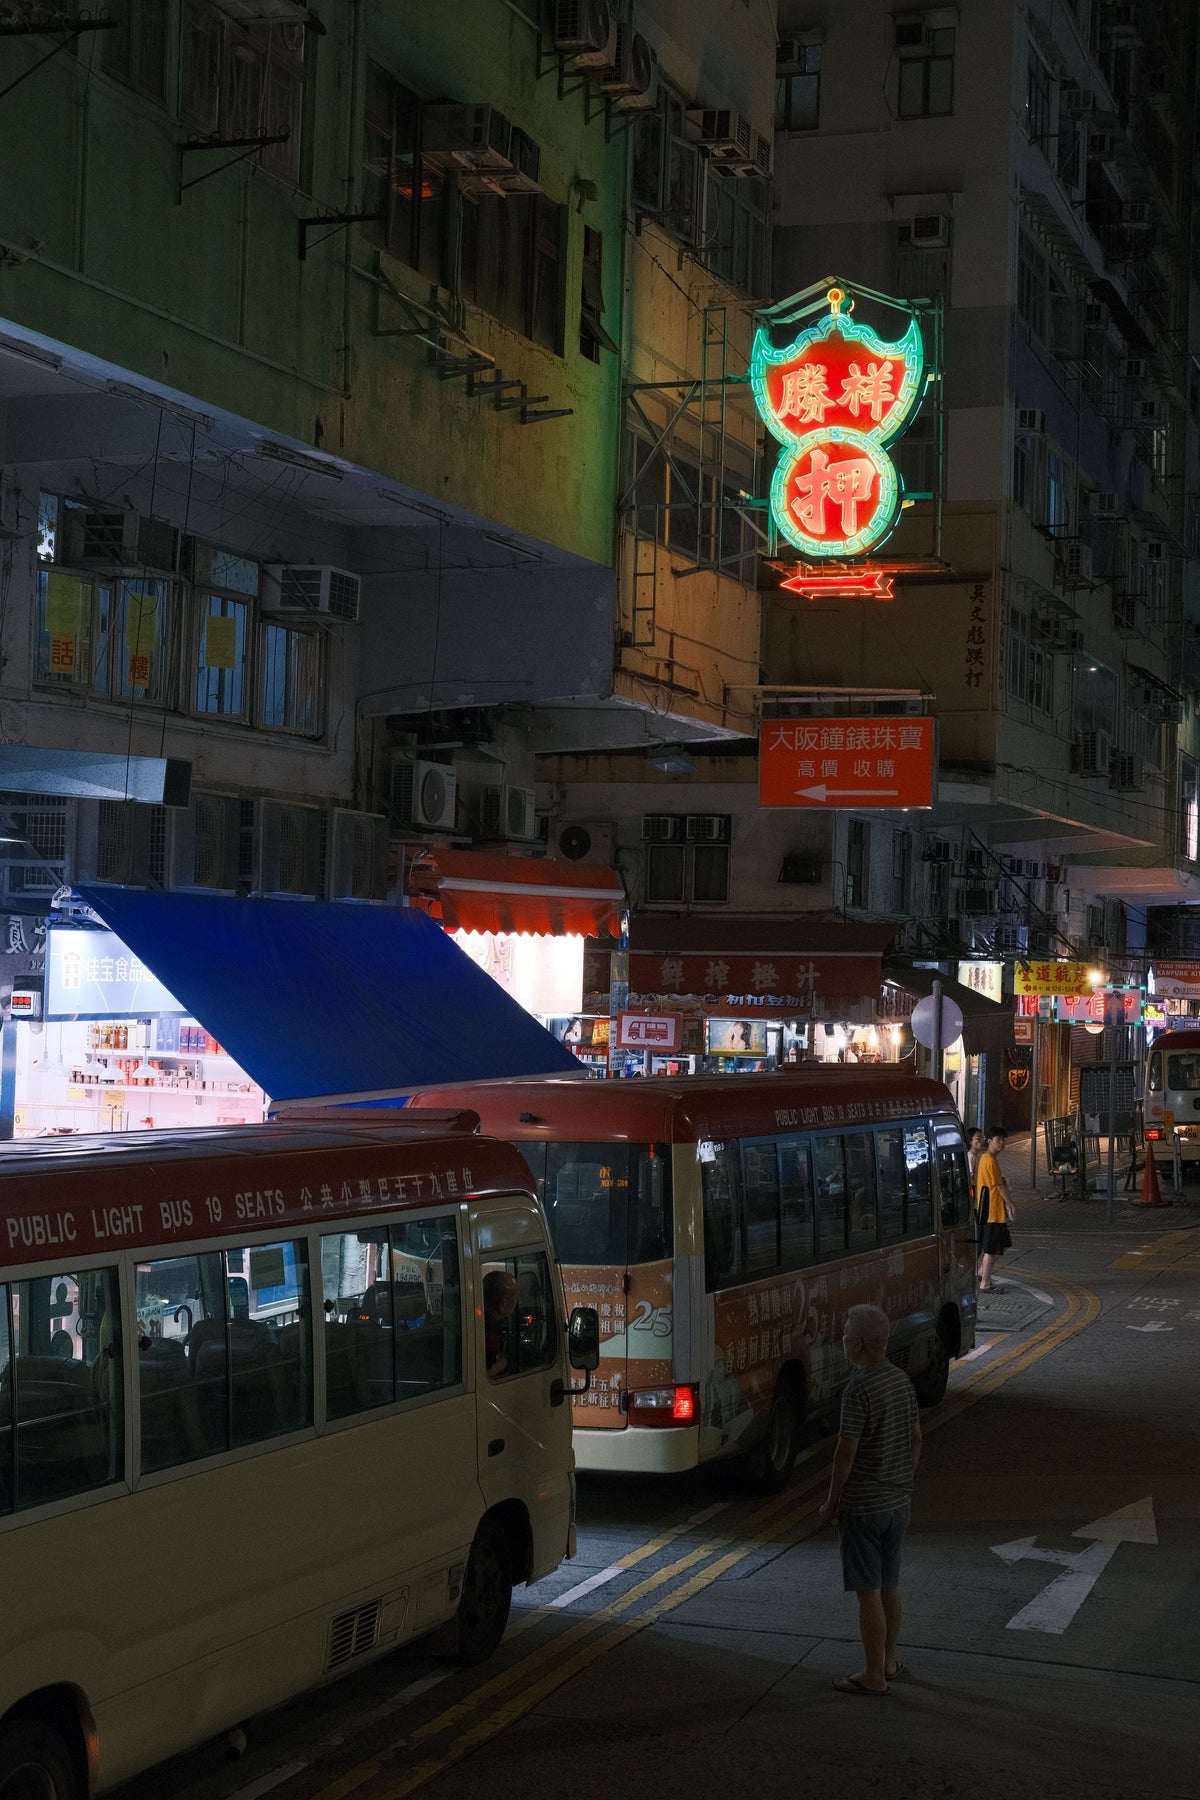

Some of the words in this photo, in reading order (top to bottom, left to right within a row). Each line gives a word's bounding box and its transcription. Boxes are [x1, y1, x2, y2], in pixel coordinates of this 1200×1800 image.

[791, 449, 876, 535] 押
[769, 726, 923, 751] 大阪鐘錶珠寶
[797, 760, 838, 778] 高價
[853, 760, 896, 777] 收購
[660, 957, 821, 991] 鮮榨橙汁
[774, 1108, 798, 1127] PUBLIC
[800, 1106, 819, 1124] LIGHT
[822, 1105, 834, 1121] BUS
[848, 1102, 866, 1119] SEATS
[300, 1167, 475, 1212] 公共小型巴士十九座位
[7, 1212, 77, 1248] PUBLIC
[92, 1204, 145, 1238] LIGHT
[160, 1199, 194, 1229] BUS
[205, 1195, 223, 1223] 19
[236, 1188, 286, 1220] SEATS
[633, 1299, 673, 1338] 25
